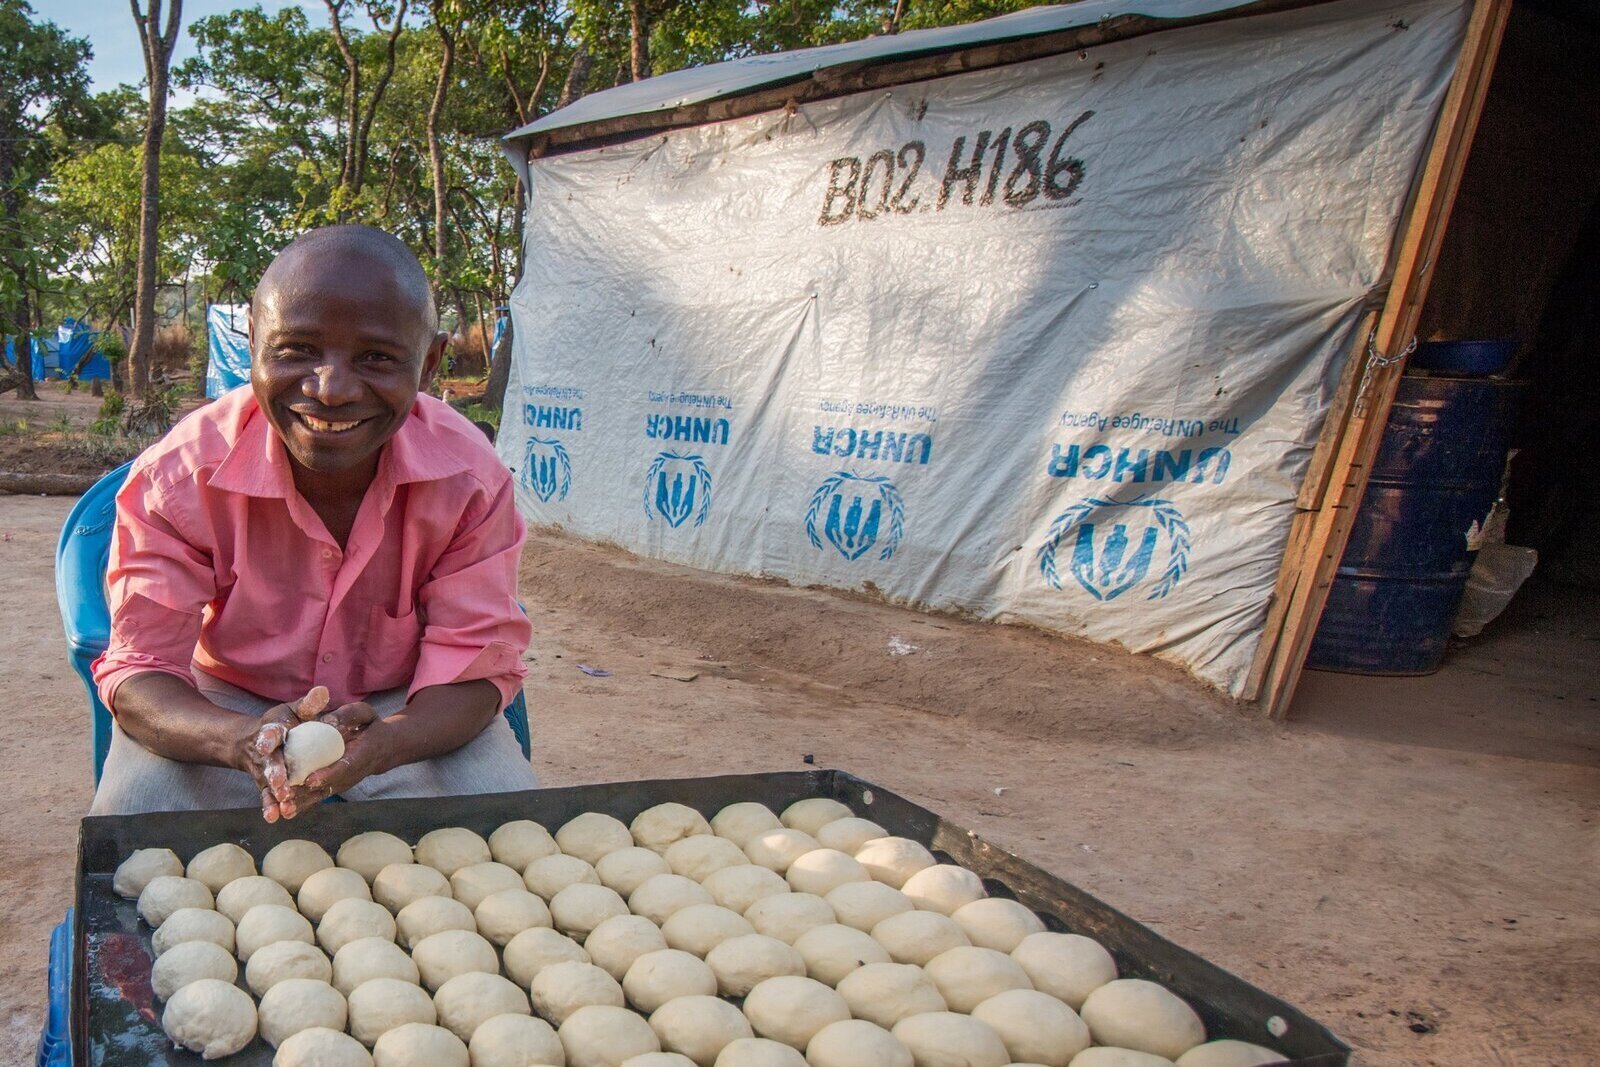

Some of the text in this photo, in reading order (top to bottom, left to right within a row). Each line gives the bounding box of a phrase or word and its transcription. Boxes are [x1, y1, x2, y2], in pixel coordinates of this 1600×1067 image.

[646, 413, 730, 445] UNHCR
[1059, 410, 1240, 437] The UN Refugee Agency
[811, 425, 932, 464] UNHCR
[1047, 443, 1232, 485] UNHCR
